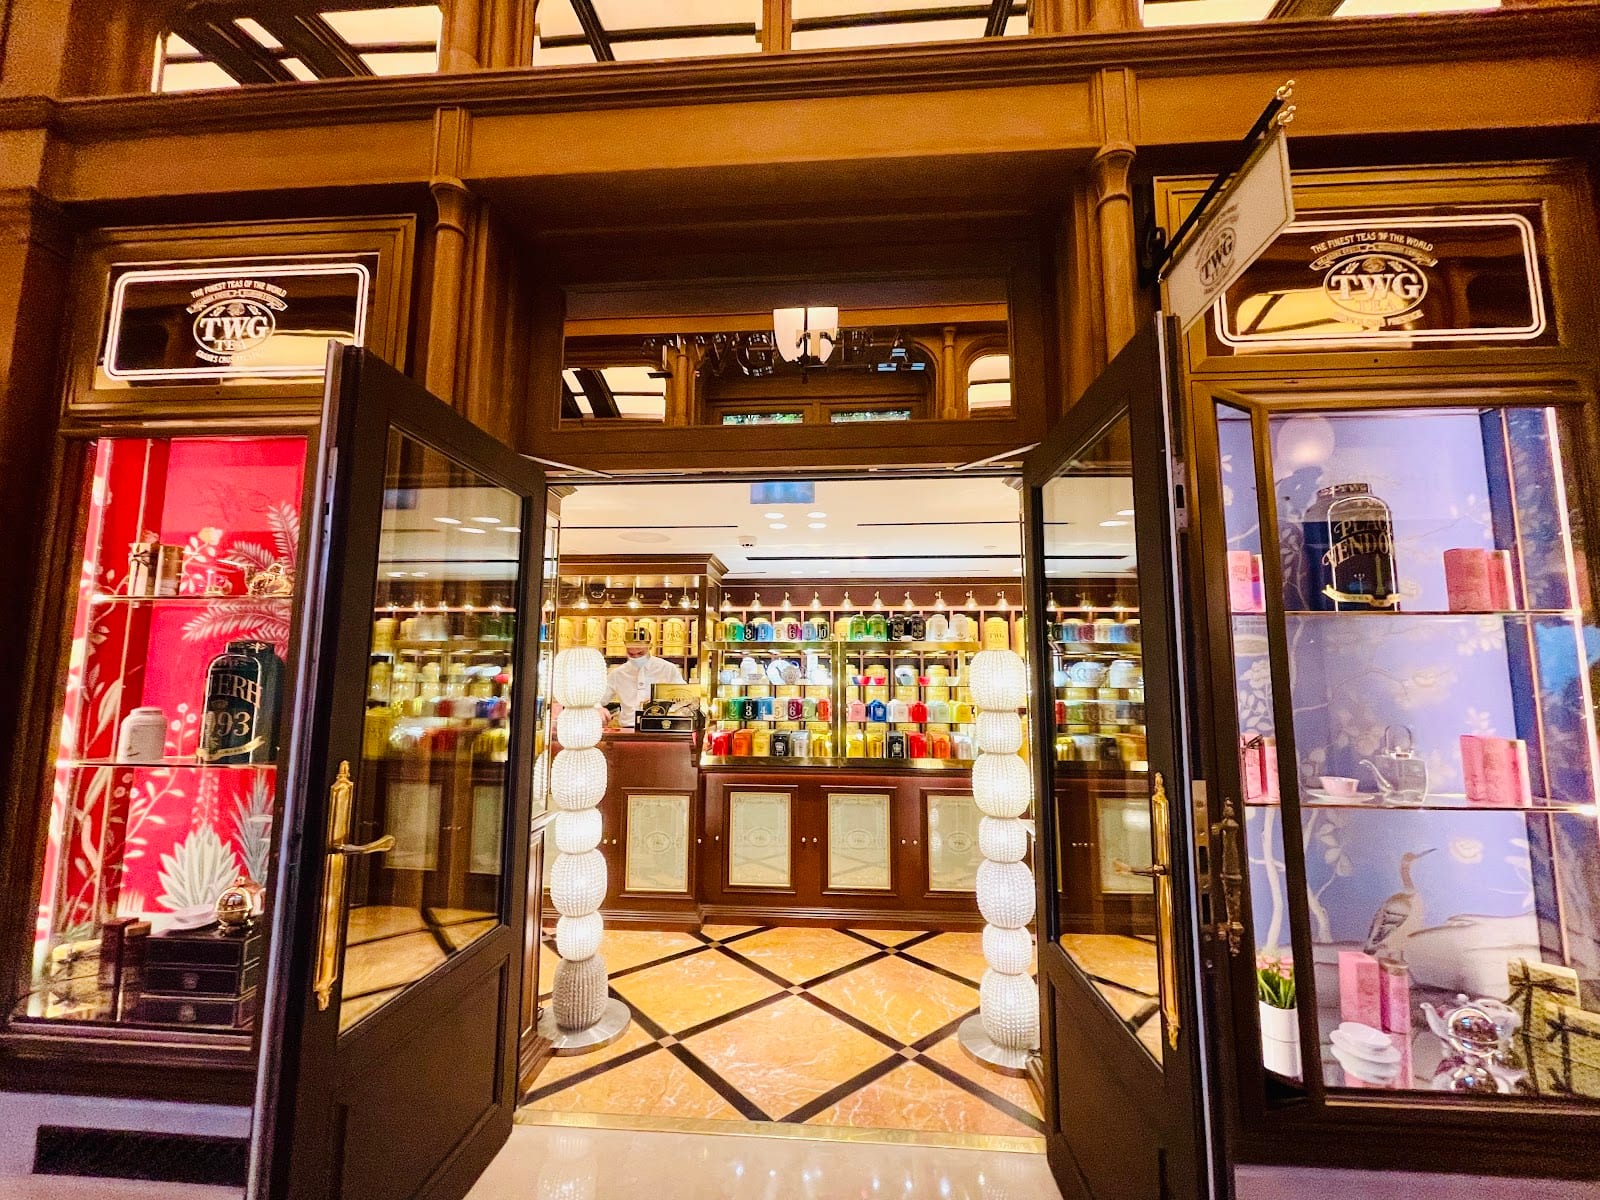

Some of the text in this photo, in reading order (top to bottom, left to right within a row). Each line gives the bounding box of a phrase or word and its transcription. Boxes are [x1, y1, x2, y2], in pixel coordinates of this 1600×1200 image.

[1310, 242, 1328, 254] THE
[1328, 234, 1355, 248] FINEST
[1355, 231, 1376, 241] TEAS
[1389, 232, 1405, 244] THE
[1406, 235, 1434, 252] WORLD
[1200, 235, 1234, 279] TWG
[226, 279, 243, 289] TEAS
[253, 280, 266, 289] THE
[1330, 272, 1422, 301] TWG
[199, 315, 270, 341] TWG
[213, 339, 247, 351] TEA
